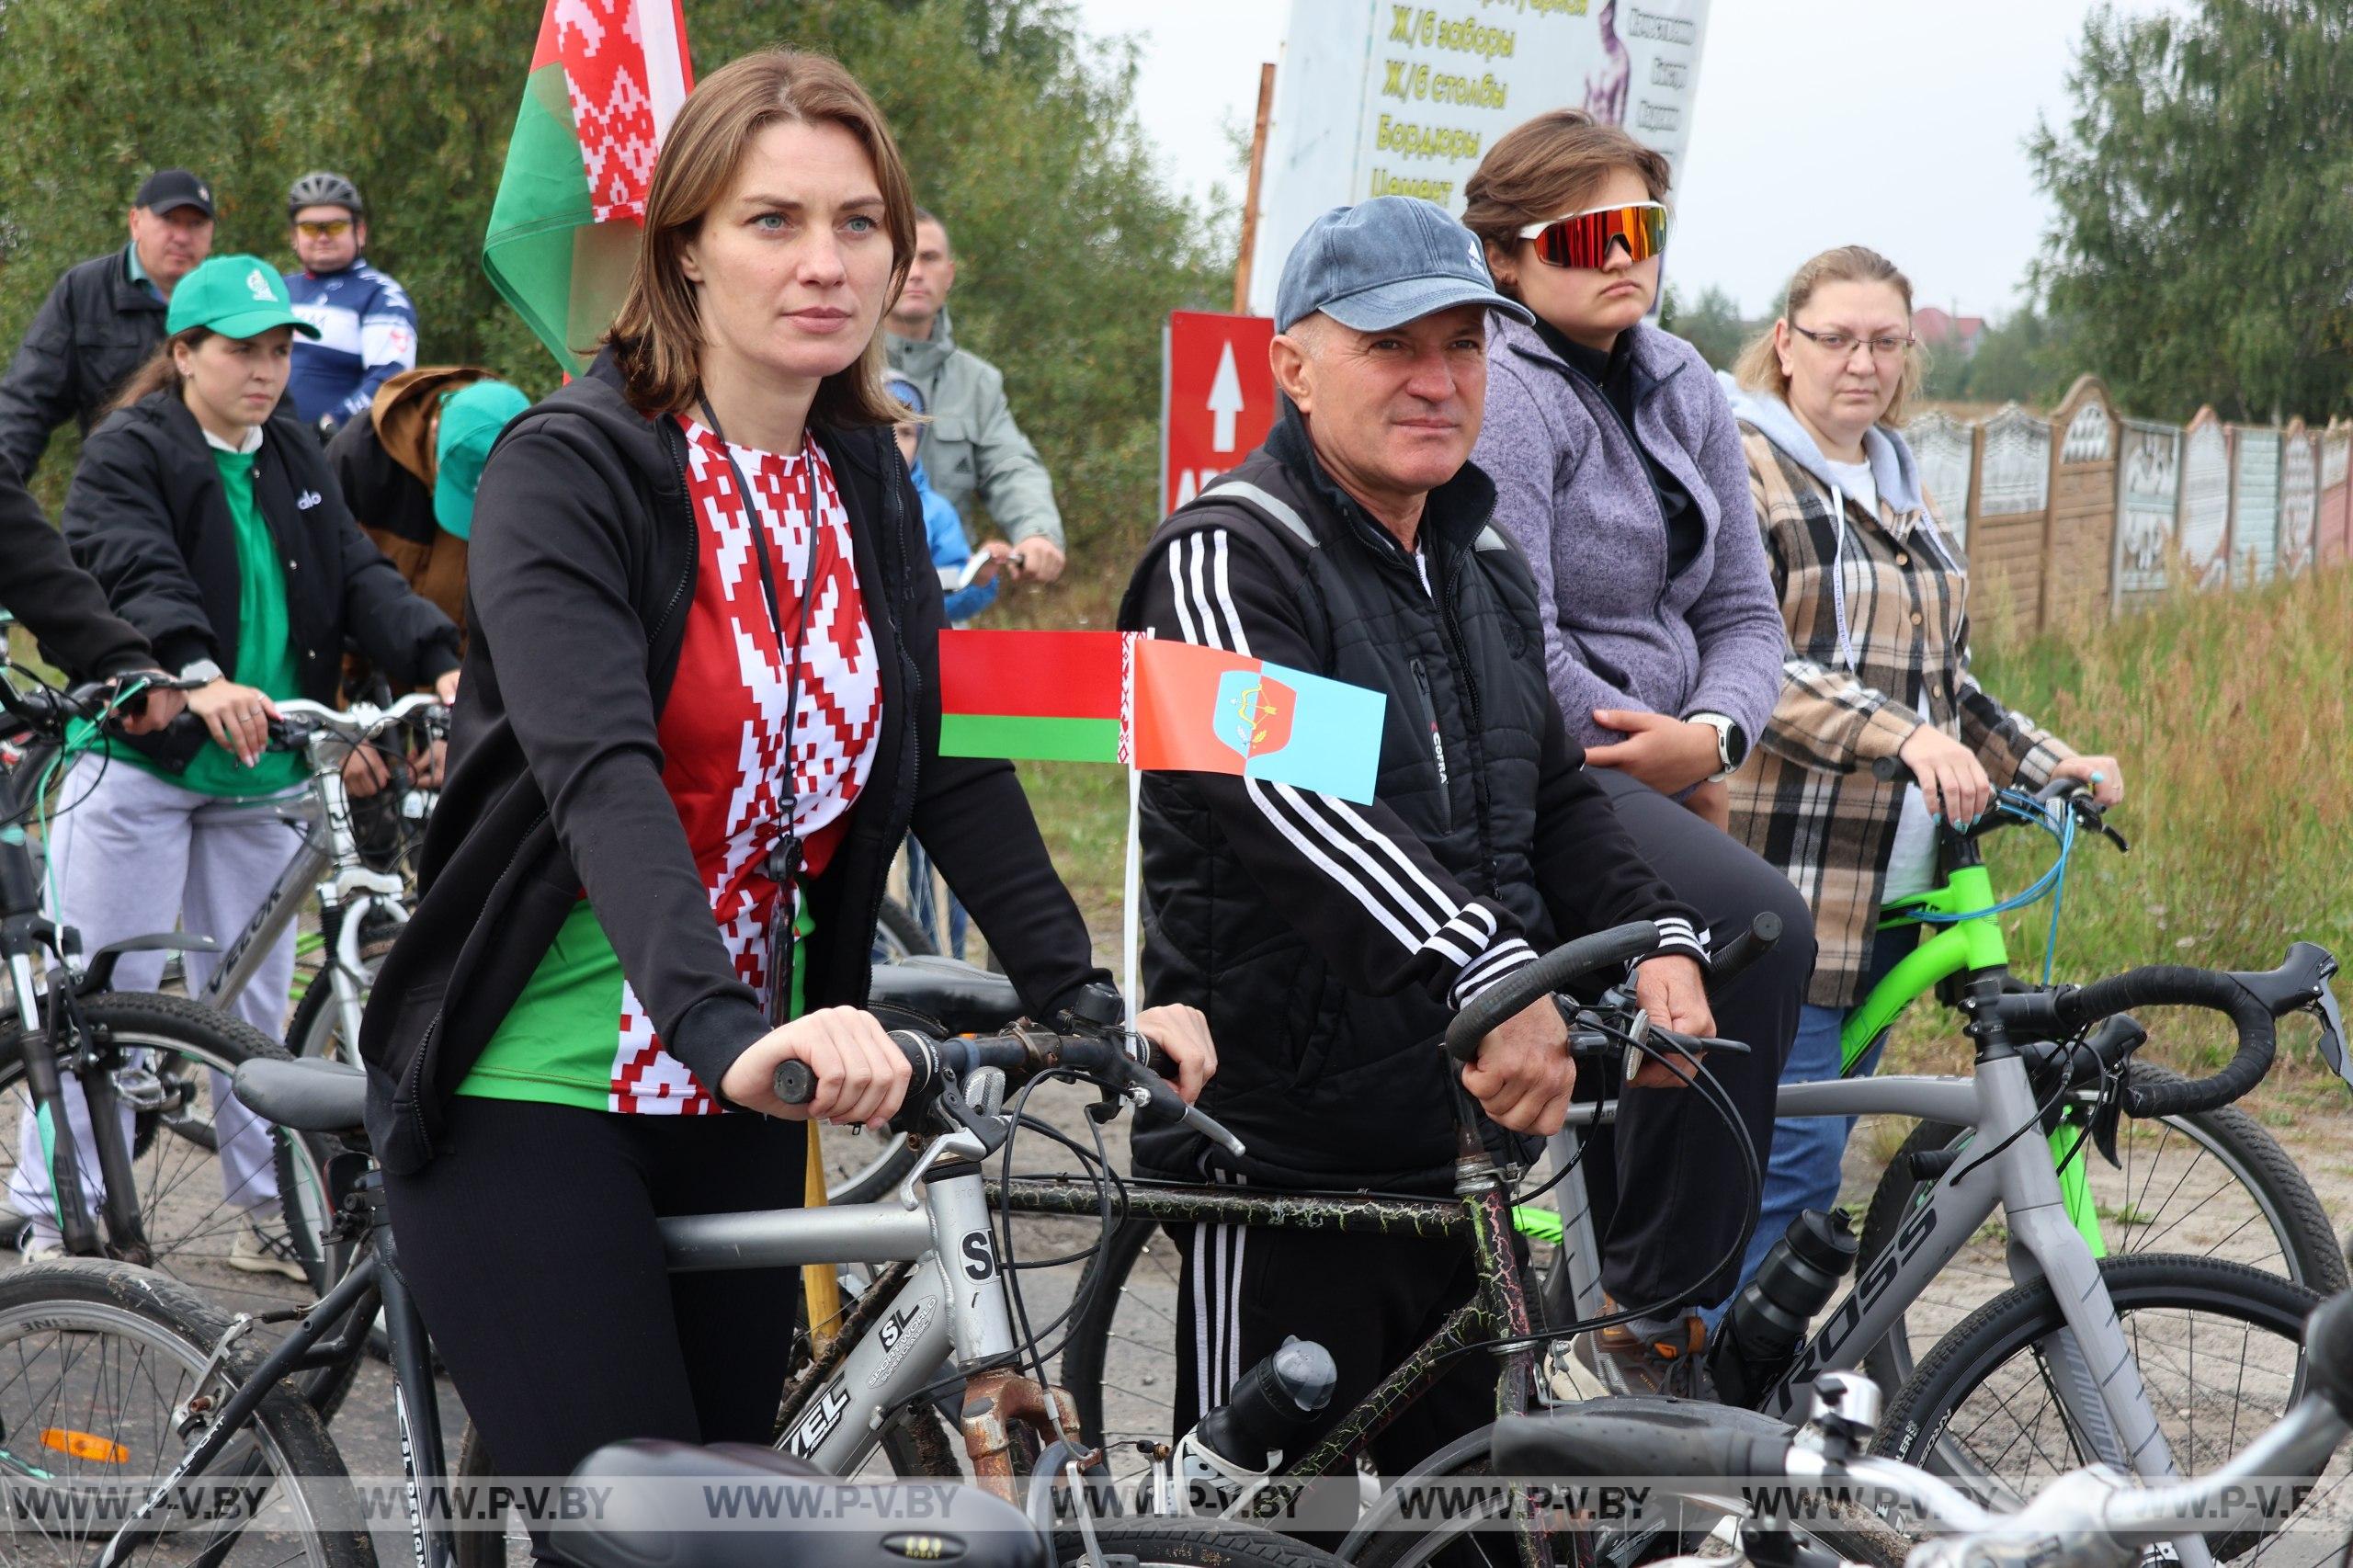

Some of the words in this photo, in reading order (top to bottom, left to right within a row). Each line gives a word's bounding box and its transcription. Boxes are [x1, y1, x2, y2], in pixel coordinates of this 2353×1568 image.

[1389, 5, 1437, 50] Ж/б
[1438, 17, 1516, 62] заборы
[1381, 59, 1430, 102] Ж/б
[1431, 73, 1508, 109] столбы
[1377, 113, 1481, 165] Бордюры
[1370, 167, 1453, 209] Цемент
[1433, 732, 1449, 784] COFRA
[880, 1304, 920, 1350] SL
[1760, 1194, 1937, 1416] ROSS
[869, 1343, 901, 1386] SPORT
[901, 1298, 937, 1344] WORLD
[881, 1354, 904, 1383] SUPER
[902, 1320, 930, 1356] CLASSIC
